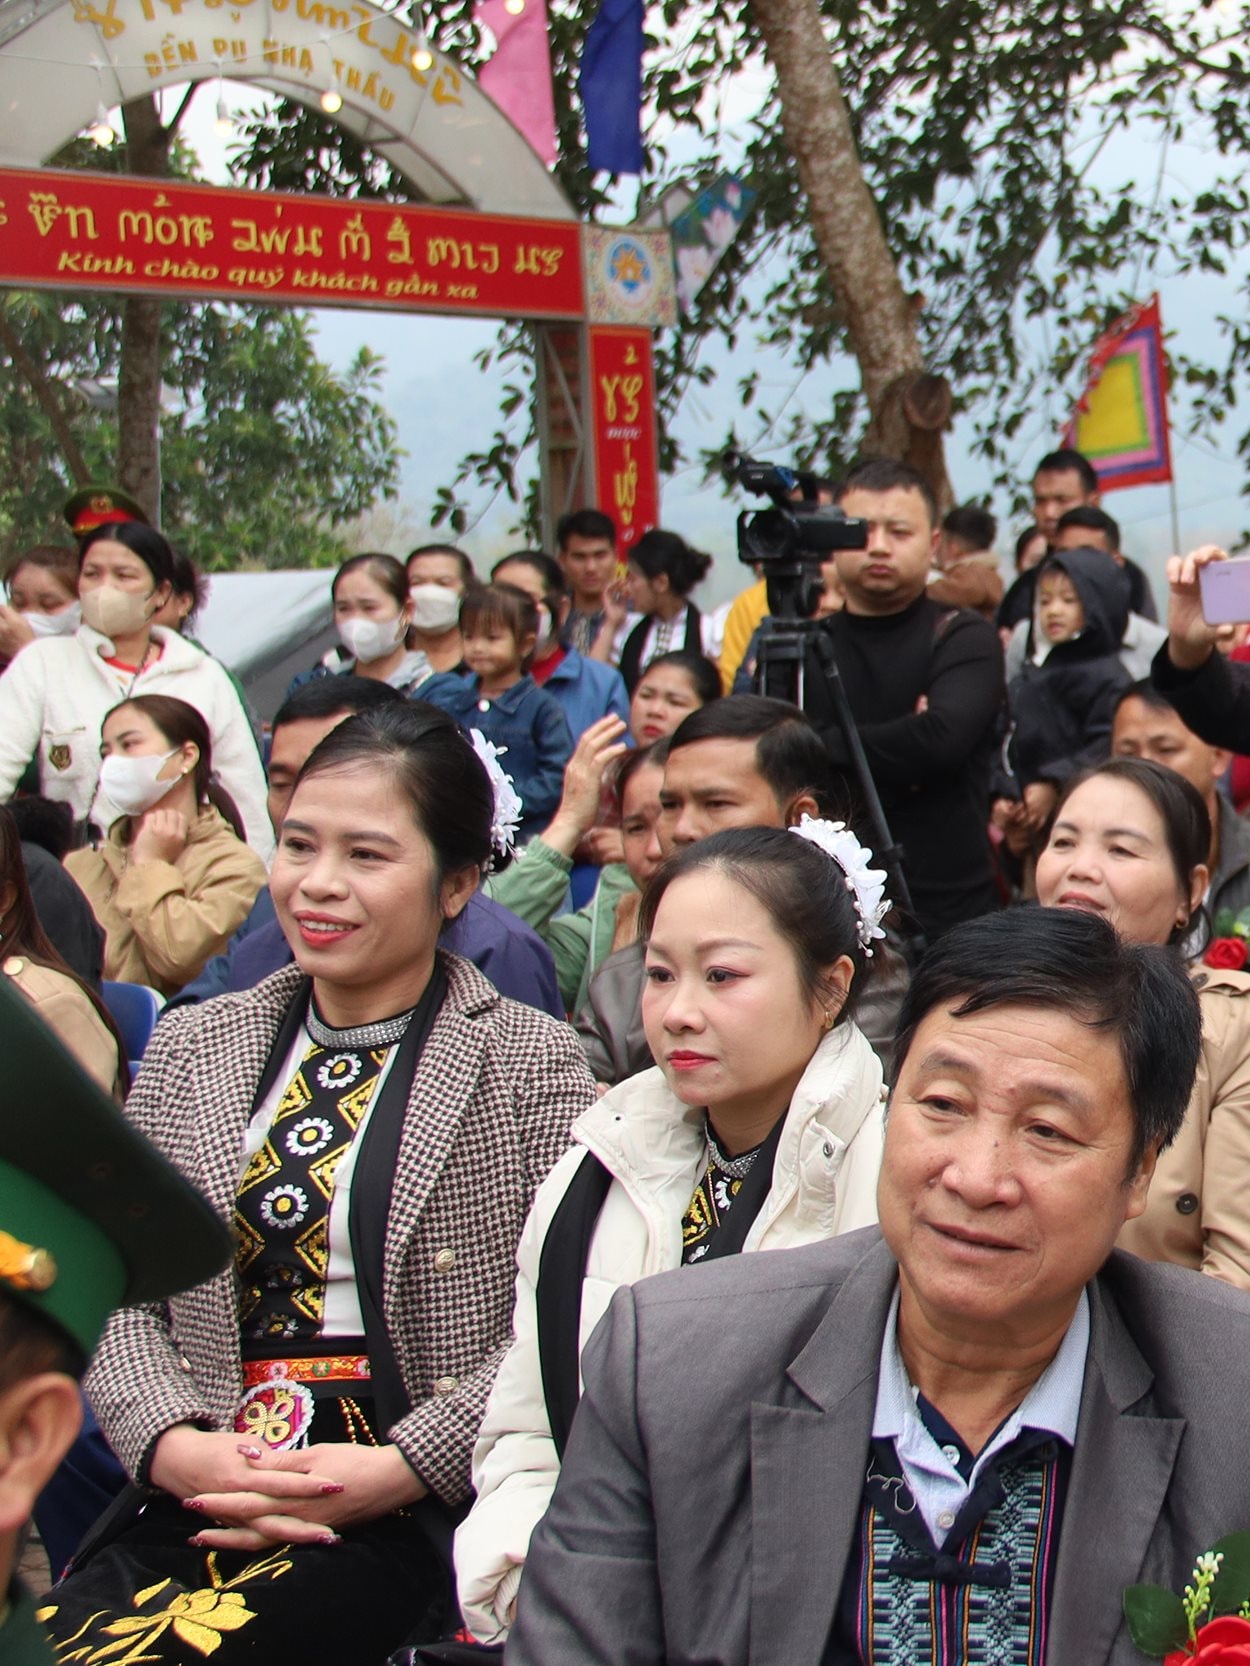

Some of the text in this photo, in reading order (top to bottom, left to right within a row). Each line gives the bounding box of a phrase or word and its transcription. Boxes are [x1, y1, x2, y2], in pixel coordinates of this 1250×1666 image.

[58, 251, 479, 299] Kính chào quý khách gần xa
